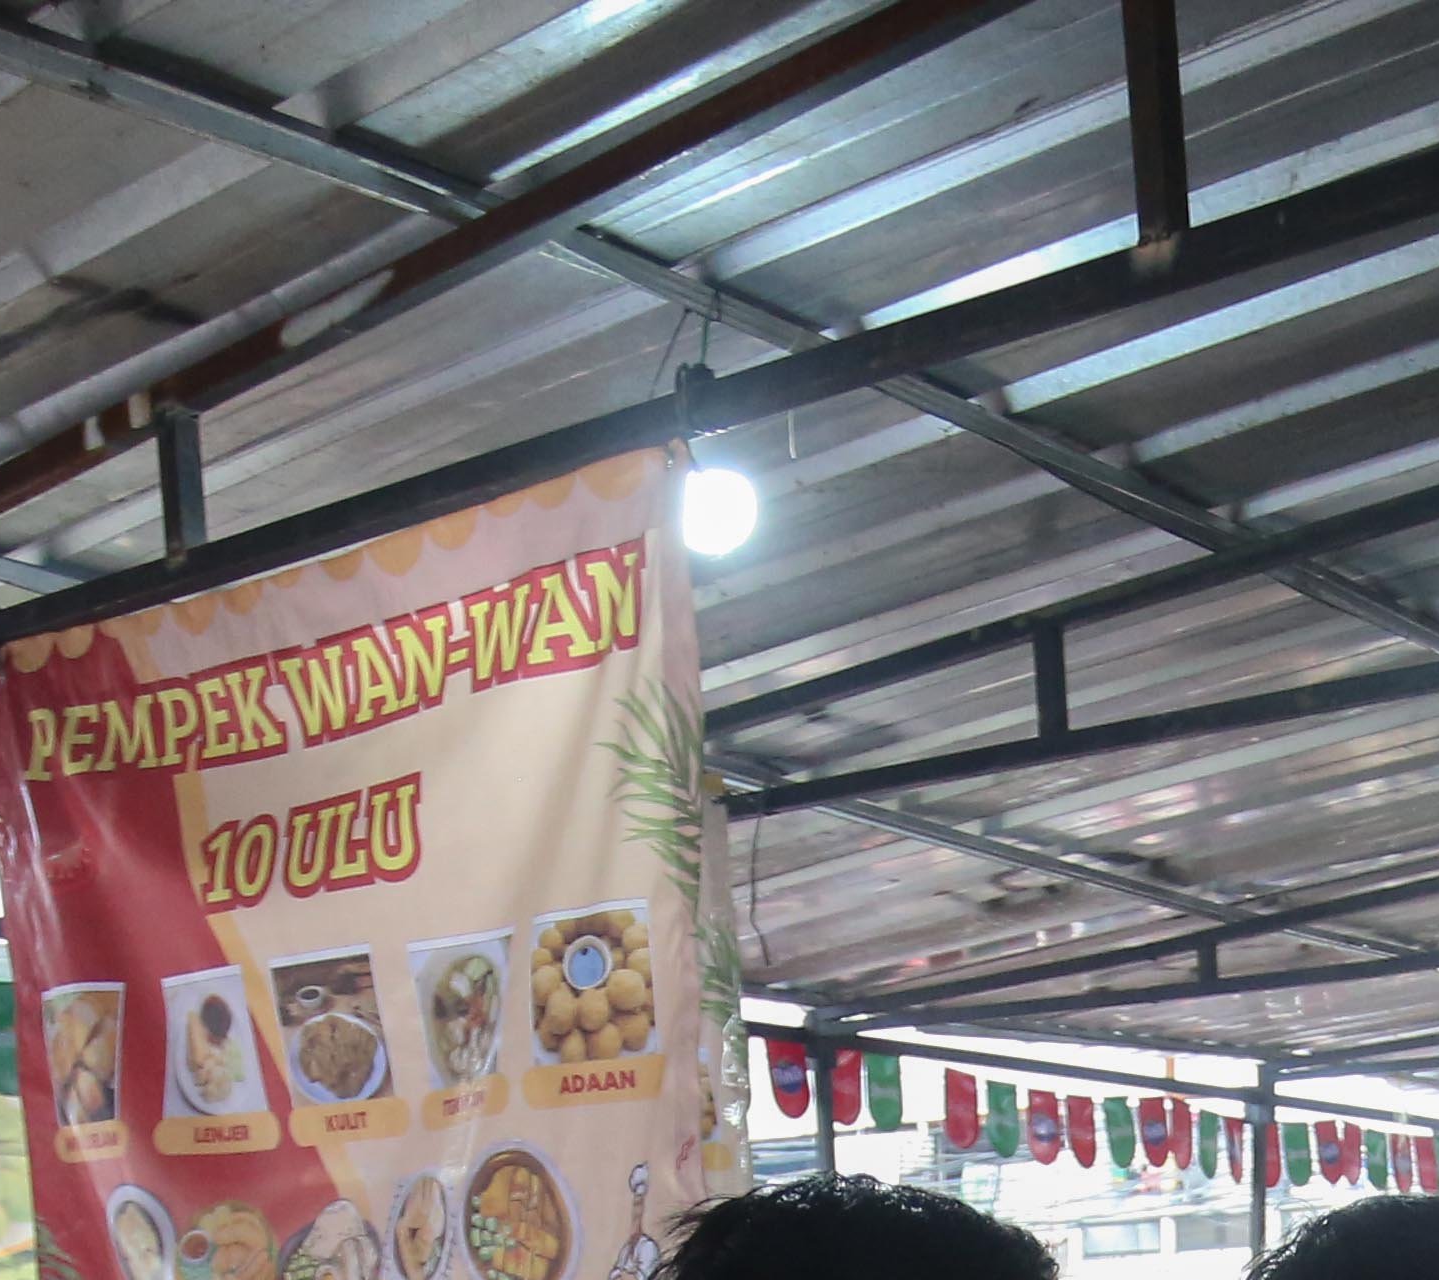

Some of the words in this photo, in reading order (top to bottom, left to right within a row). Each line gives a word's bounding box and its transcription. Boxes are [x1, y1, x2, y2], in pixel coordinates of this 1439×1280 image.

[25, 662, 285, 782] PEMPEK
[280, 550, 643, 742] WAN-WAN
[203, 825, 273, 904] 10
[285, 784, 417, 890] ULU
[558, 1066, 636, 1094] ADAAN
